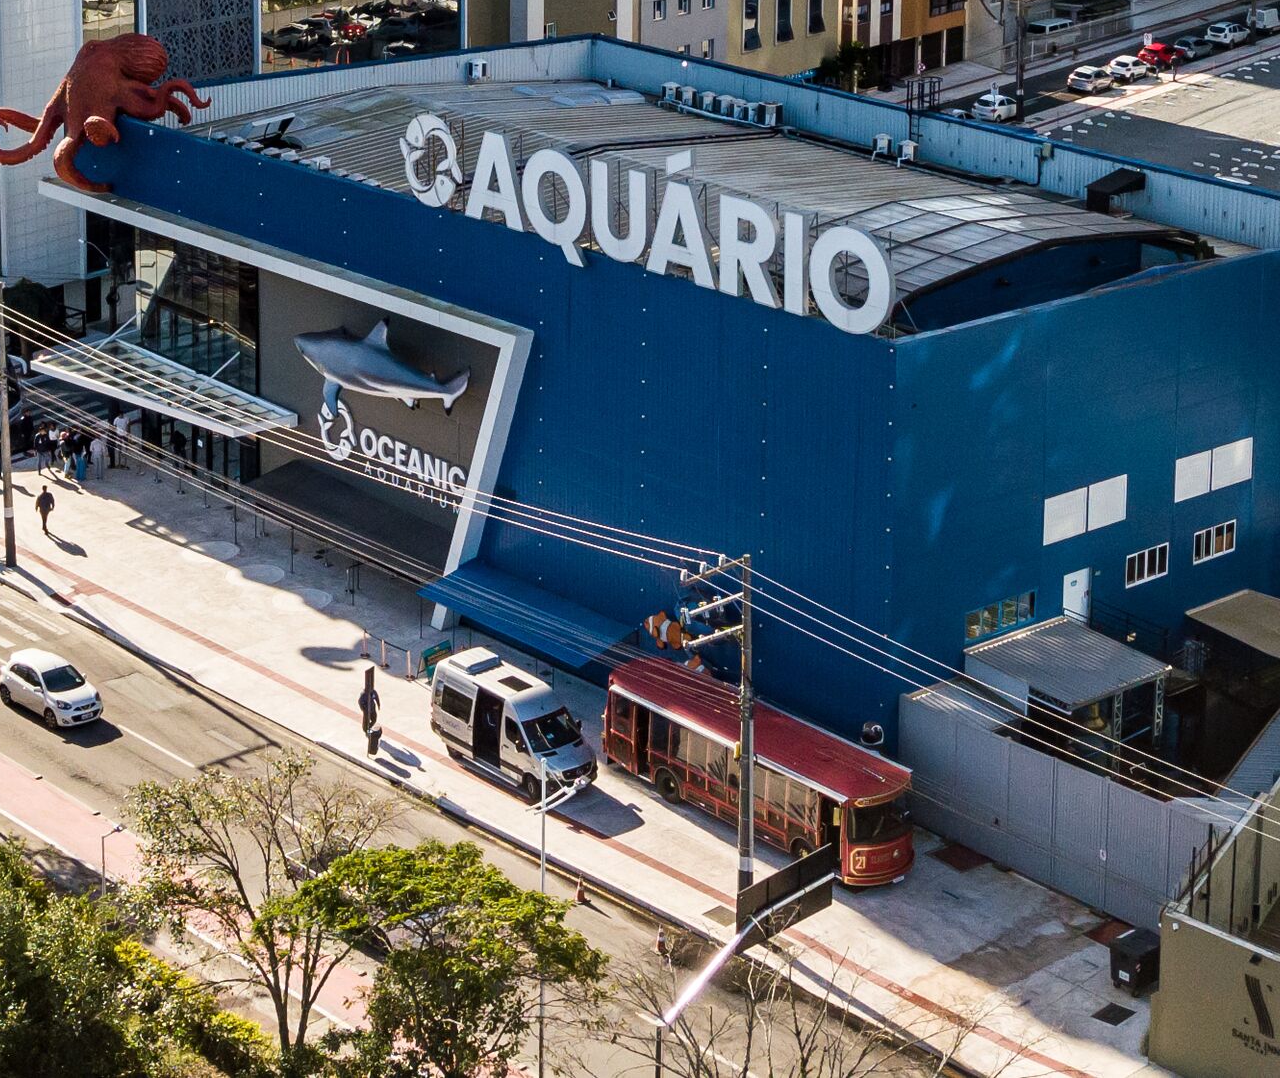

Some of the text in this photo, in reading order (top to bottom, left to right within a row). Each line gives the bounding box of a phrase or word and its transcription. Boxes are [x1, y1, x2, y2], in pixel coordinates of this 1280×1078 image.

[465, 129, 896, 336] AQUÁRIO
[360, 428, 465, 495] OCEANIC
[364, 461, 460, 514] AQUARIUM
